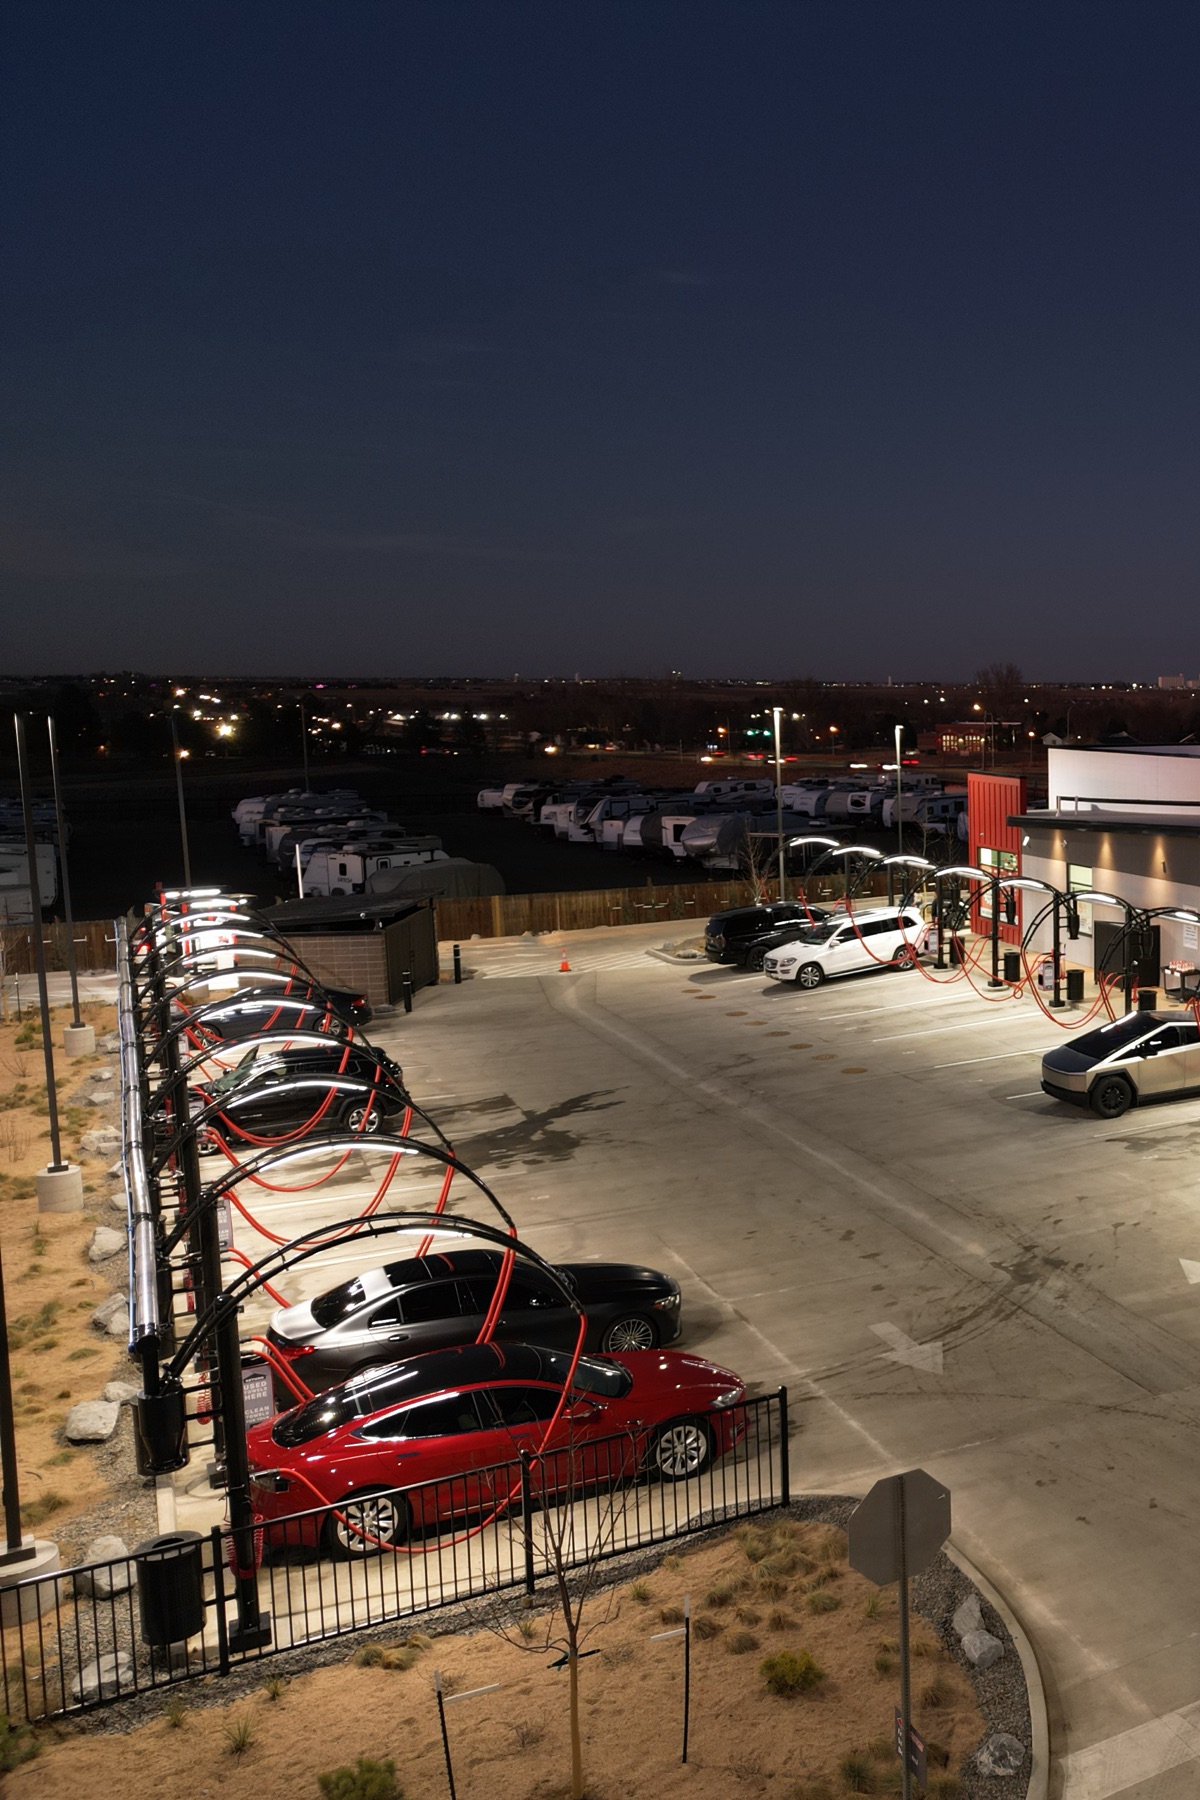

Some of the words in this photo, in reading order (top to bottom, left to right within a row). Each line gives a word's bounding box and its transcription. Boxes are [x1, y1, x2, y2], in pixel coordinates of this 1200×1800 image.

[243, 1381, 267, 1390] USED
[244, 1386, 267, 1395] TOWELS
[244, 1391, 267, 1400] HERE
[245, 1406, 269, 1414] CLEAN
[245, 1411, 269, 1419] TOWELS
